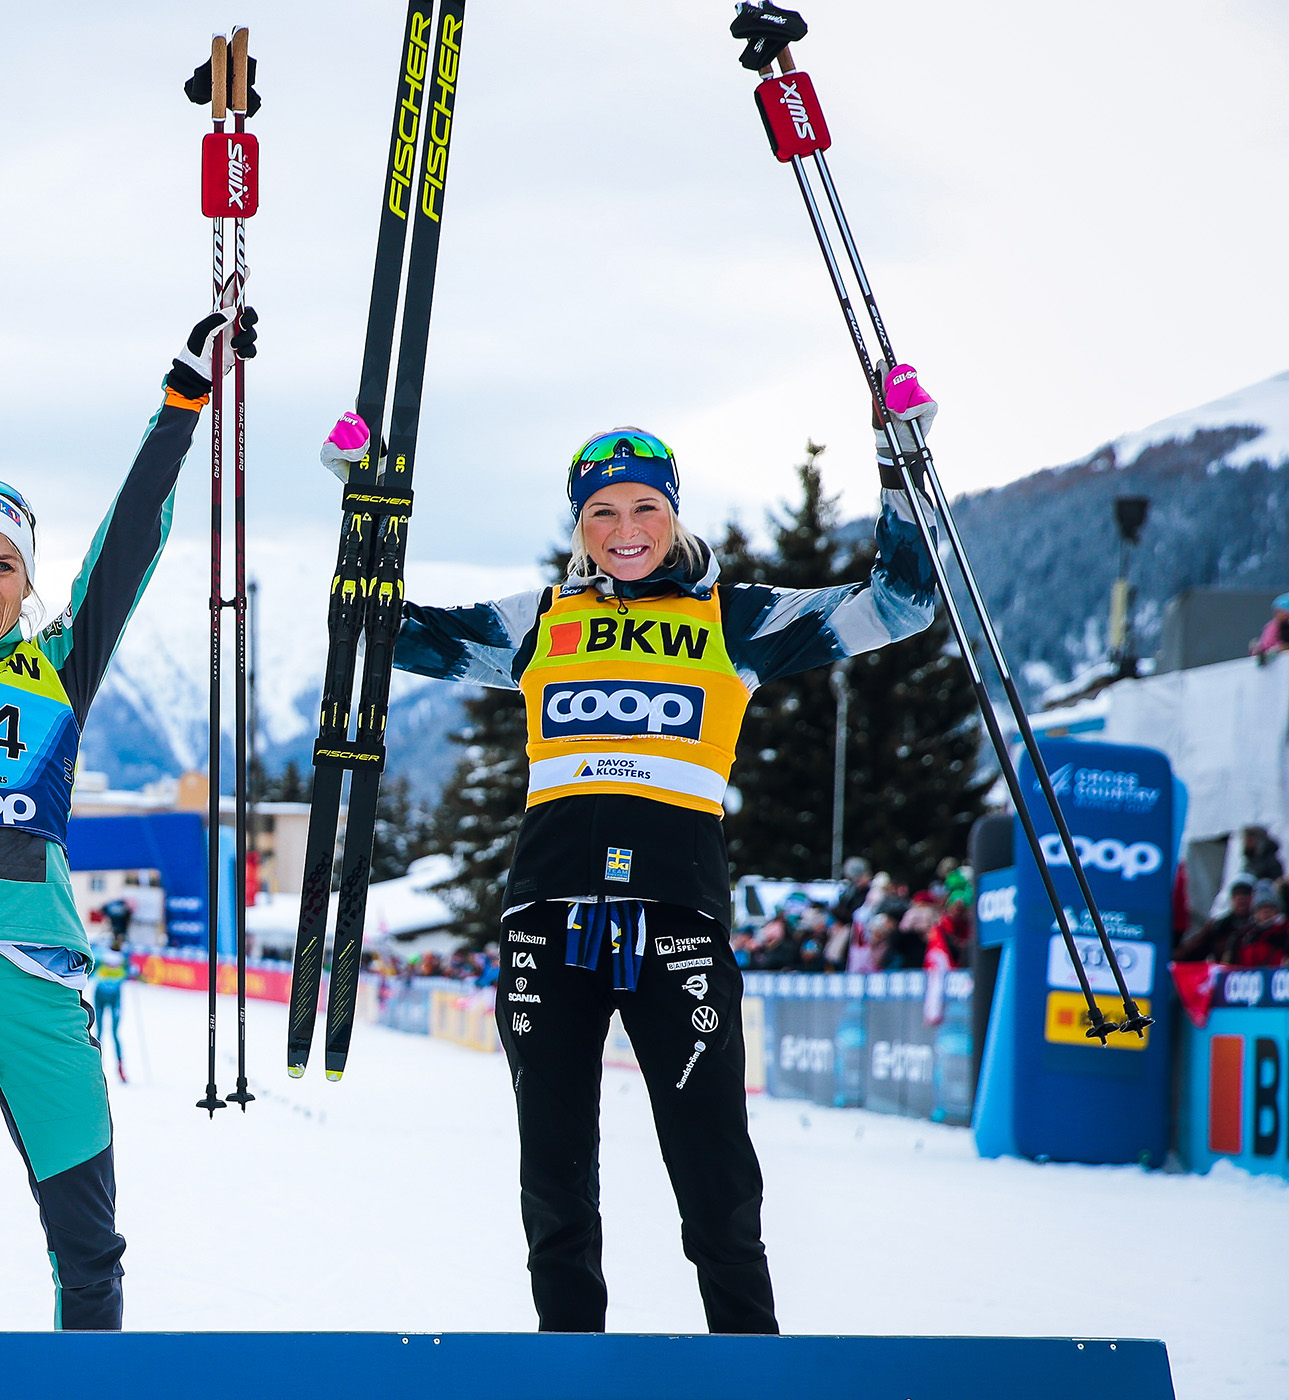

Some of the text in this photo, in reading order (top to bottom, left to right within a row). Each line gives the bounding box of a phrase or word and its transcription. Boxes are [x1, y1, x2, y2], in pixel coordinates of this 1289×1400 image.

[388, 12, 431, 221] FISCHER
[422, 14, 463, 224] FISCHER
[396, 456, 406, 473] 3D
[345, 493, 412, 507] FISCHER
[585, 617, 710, 660] BKW
[547, 688, 694, 732] coop
[316, 748, 381, 762] FISCHER
[595, 767, 651, 780] KLOSTERS
[507, 930, 547, 946] Folksam
[675, 936, 712, 946] SVENSKA
[676, 945, 698, 953] SPEL
[512, 951, 538, 970] ICA
[668, 957, 712, 970] BAUHAUS
[508, 992, 542, 1004] SCANIA
[512, 1012, 532, 1037] life
